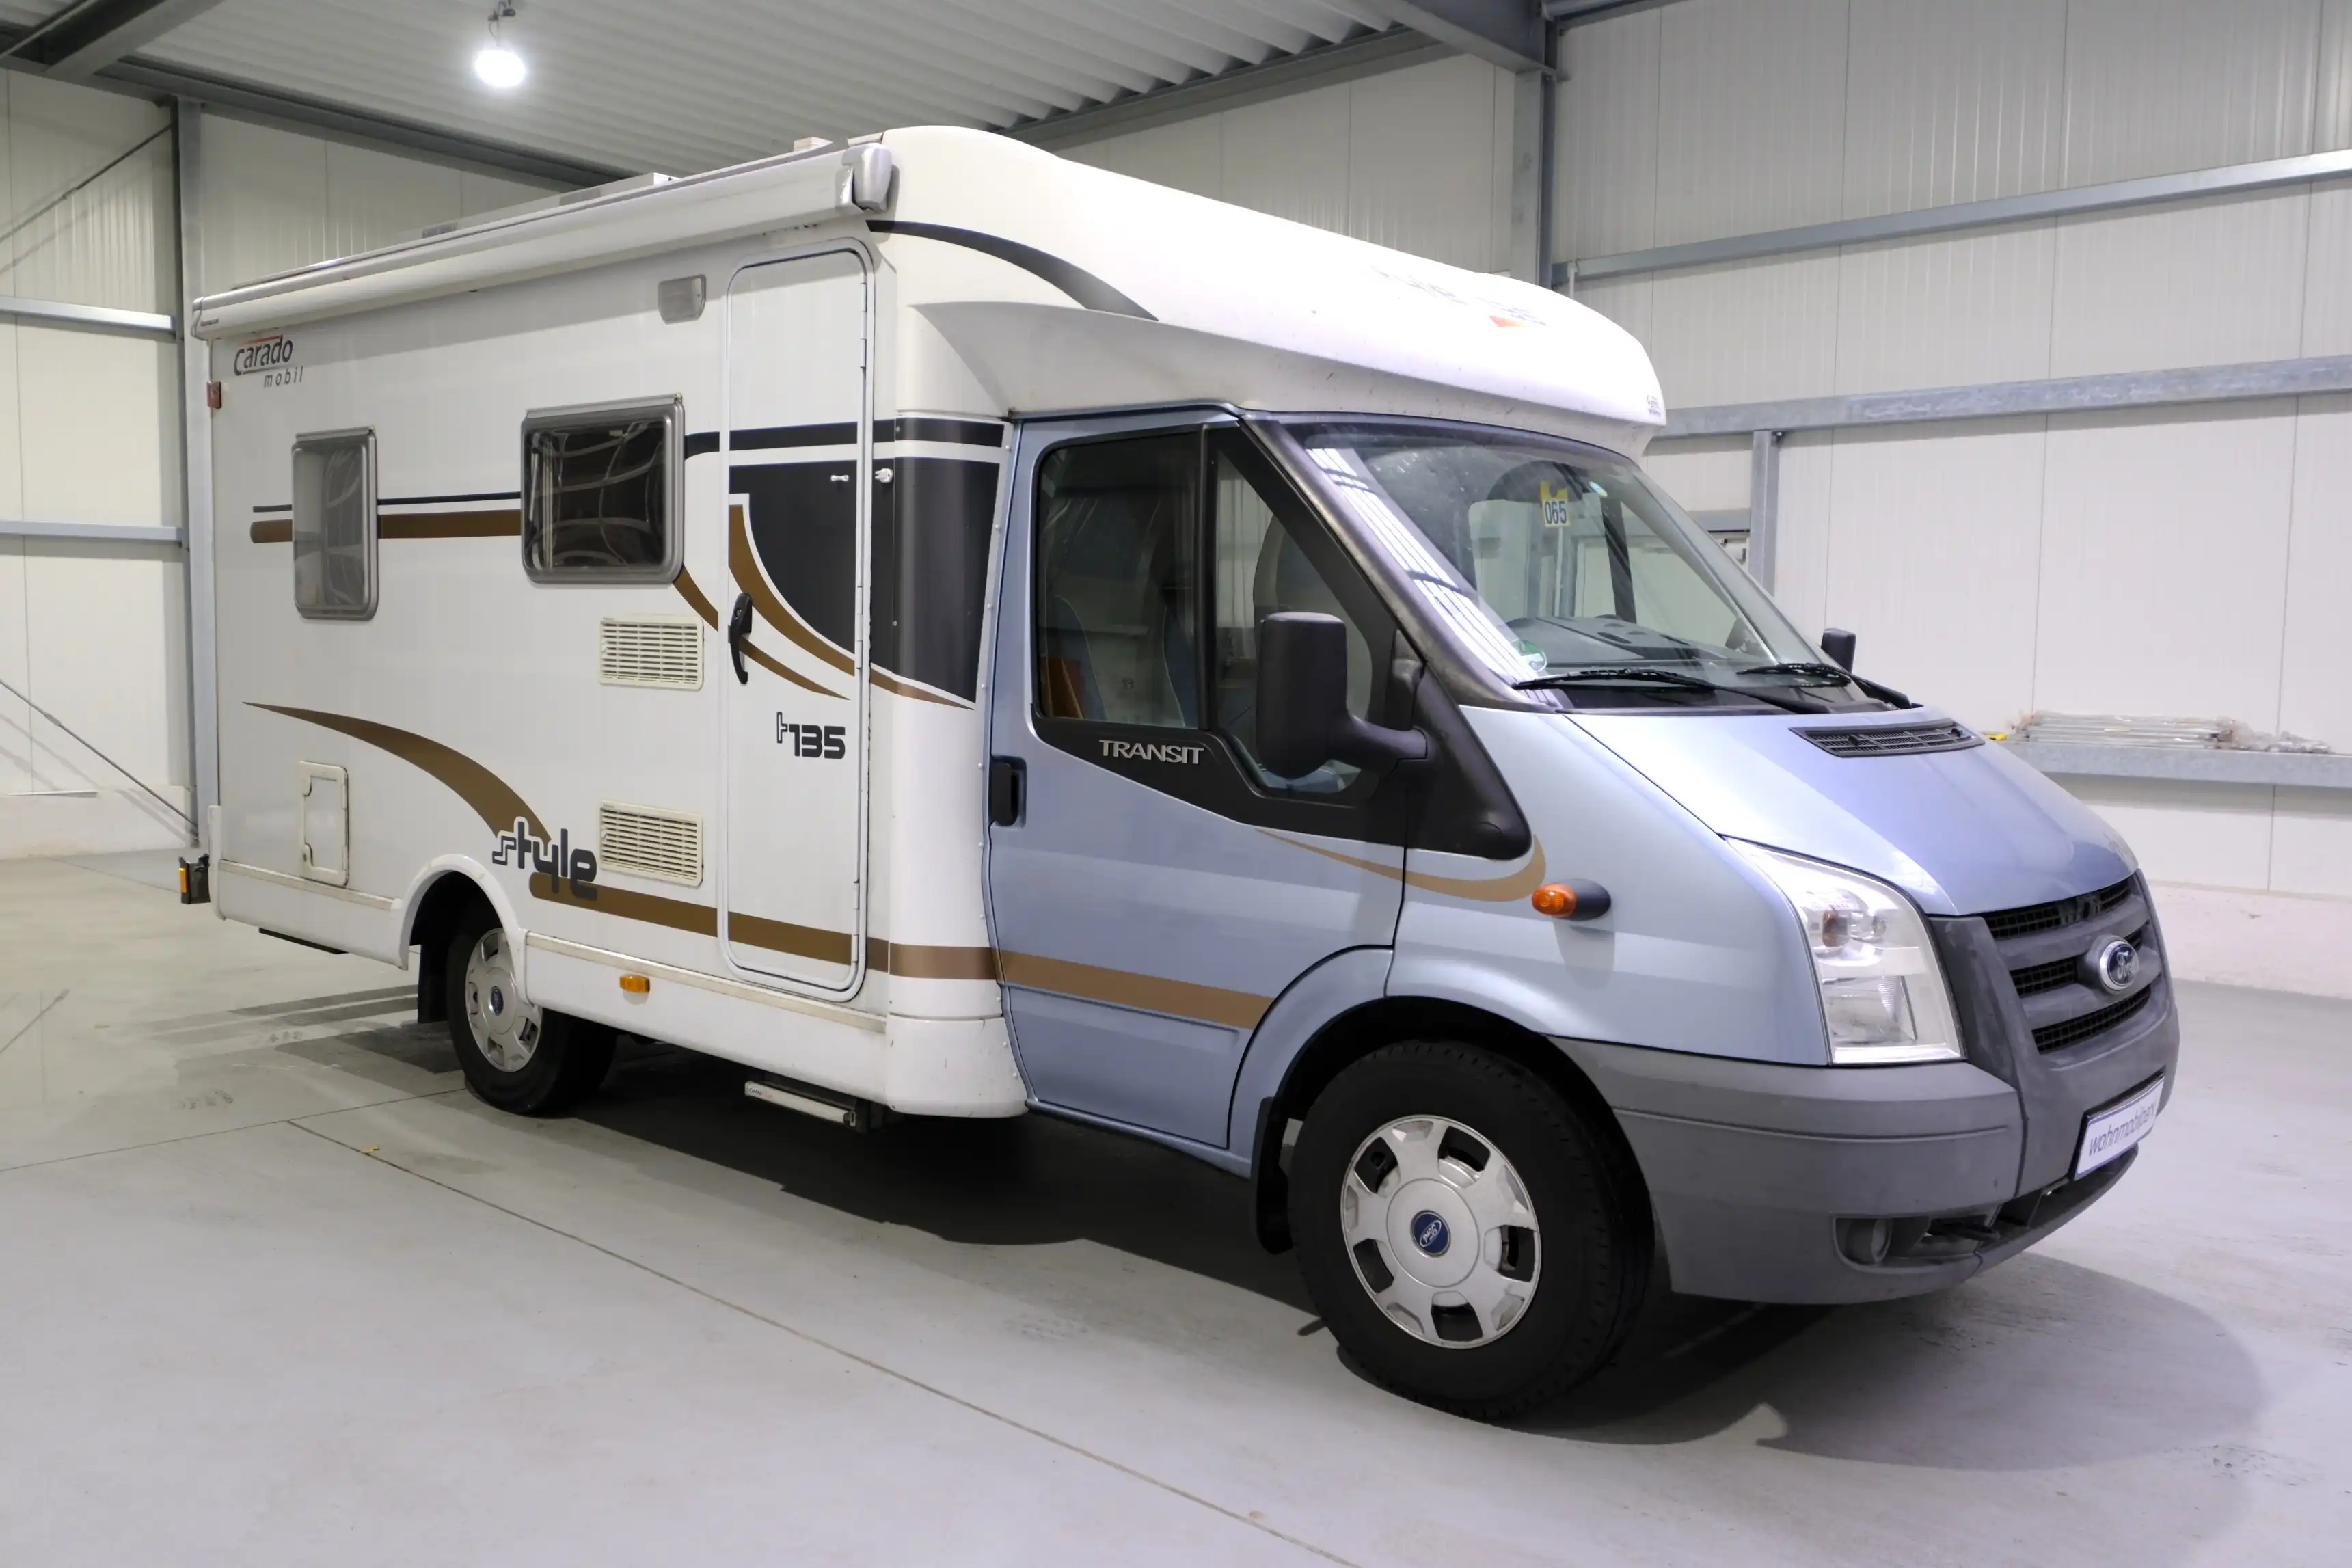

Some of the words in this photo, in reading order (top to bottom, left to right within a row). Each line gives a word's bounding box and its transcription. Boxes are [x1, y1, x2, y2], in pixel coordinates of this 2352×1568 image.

[264, 366, 303, 388] mobil
[1544, 500, 1567, 525] 065
[1098, 739, 1204, 764] TRANSIT
[491, 820, 598, 901] style
